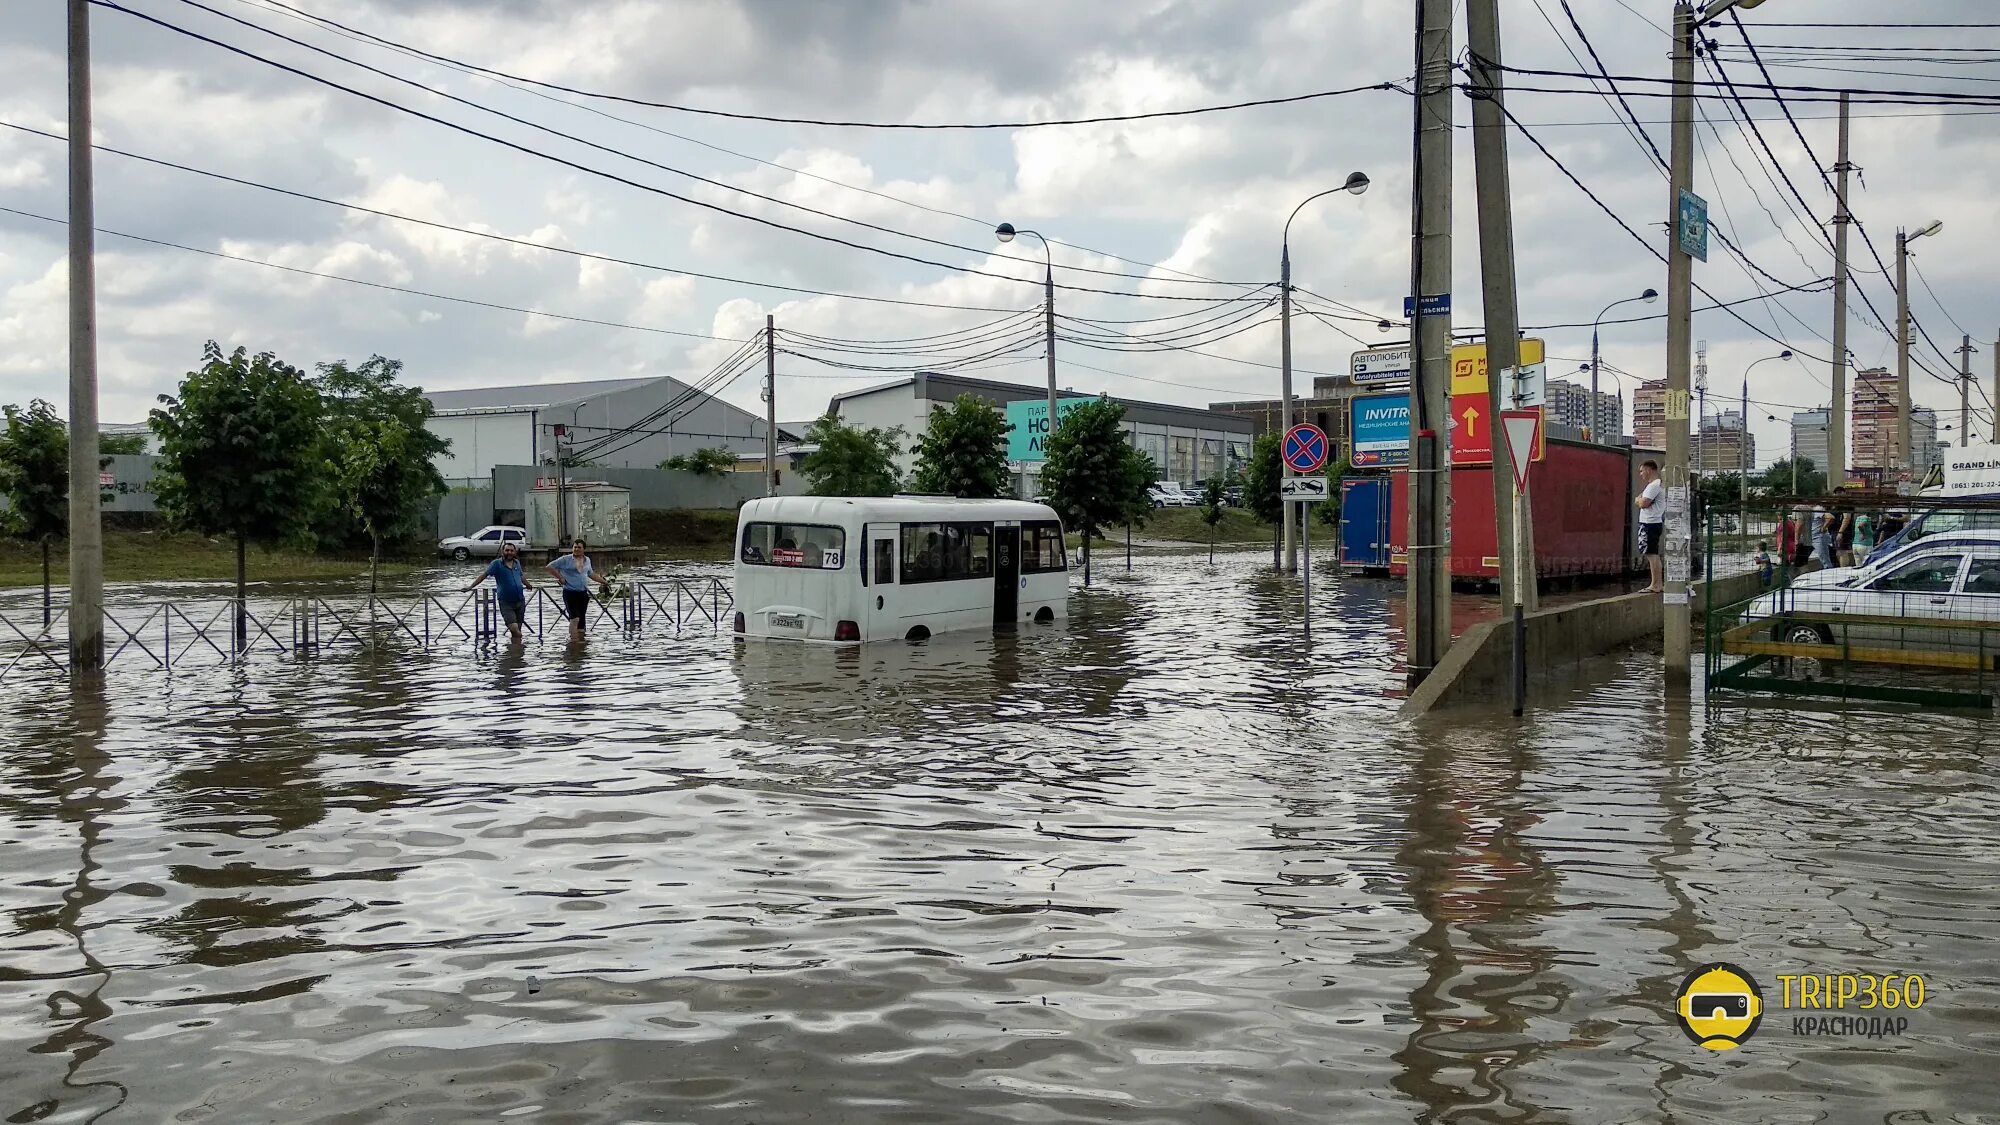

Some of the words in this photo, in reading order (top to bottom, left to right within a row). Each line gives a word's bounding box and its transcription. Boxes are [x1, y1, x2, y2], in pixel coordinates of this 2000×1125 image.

[1028, 405, 1066, 416] ПАРИЯ
[1365, 407, 1411, 420] INVITR
[1952, 461, 1985, 469] GRAND
[824, 552, 839, 565] 78
